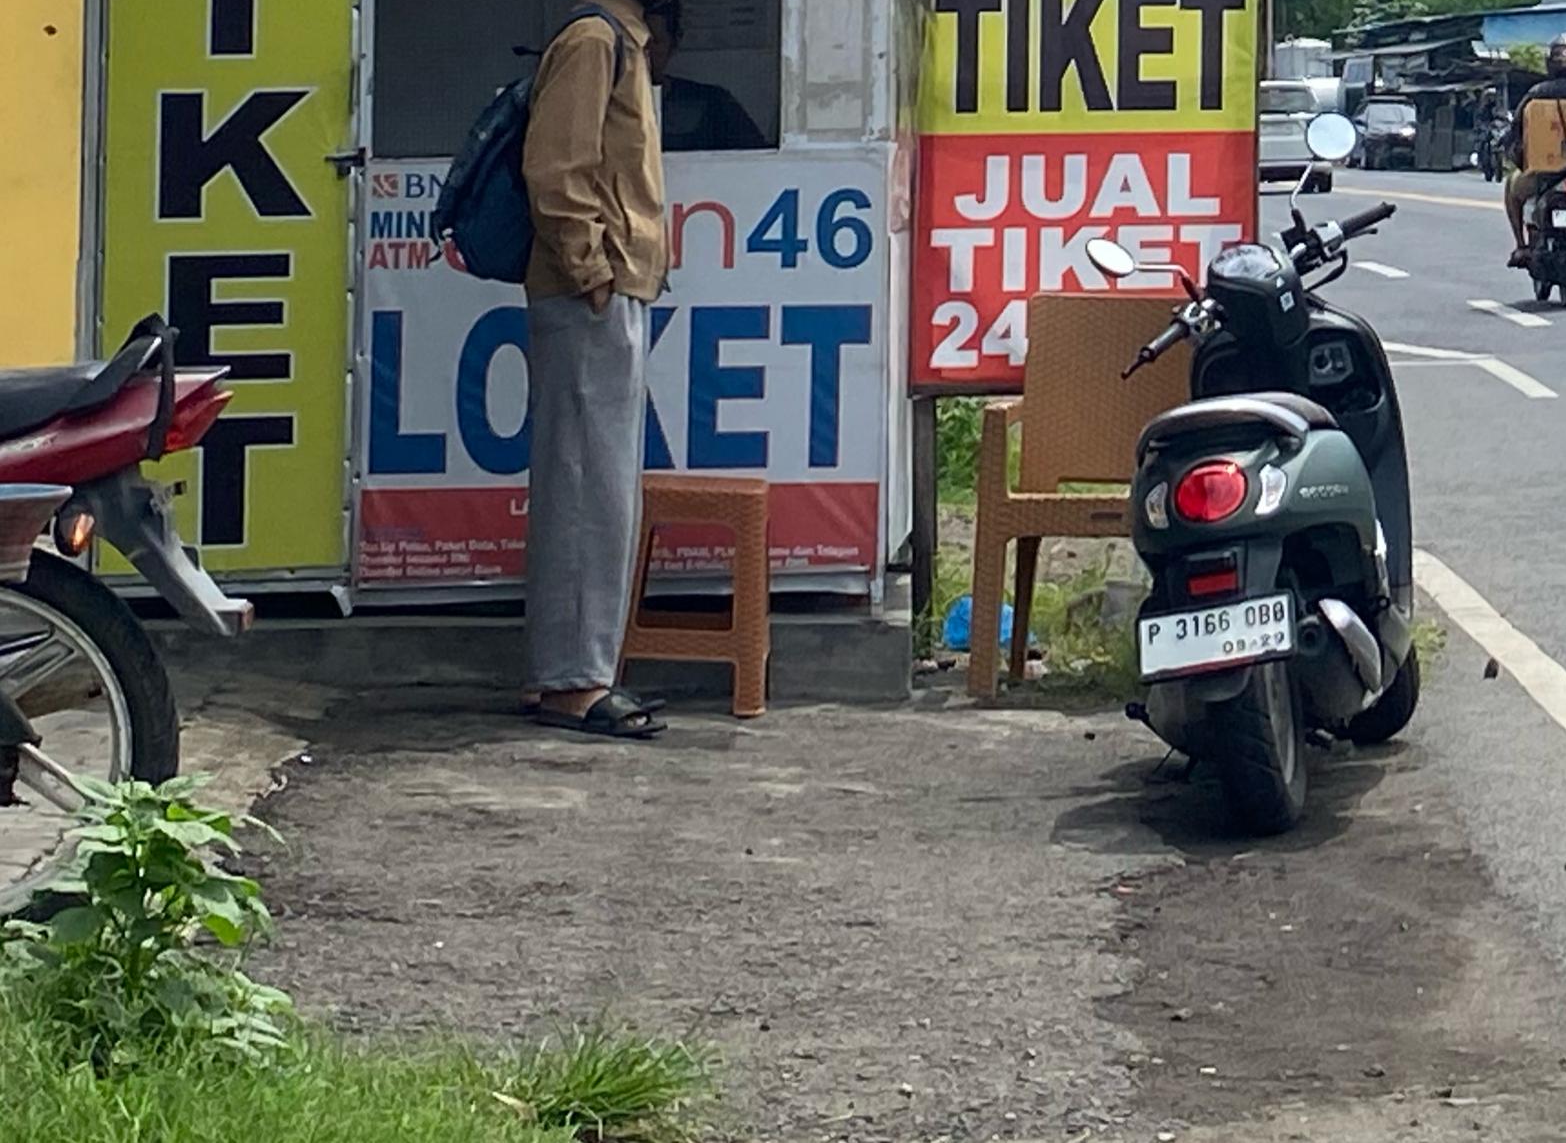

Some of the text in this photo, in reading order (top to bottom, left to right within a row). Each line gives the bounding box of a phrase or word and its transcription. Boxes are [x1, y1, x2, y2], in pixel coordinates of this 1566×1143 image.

[953, 153, 1221, 221] JUAL
[369, 242, 432, 269] ATM
[930, 223, 1243, 293] TIKET
[929, 300, 1029, 369] 24
[1148, 623, 1161, 645] P
[1175, 610, 1231, 640] 3166
